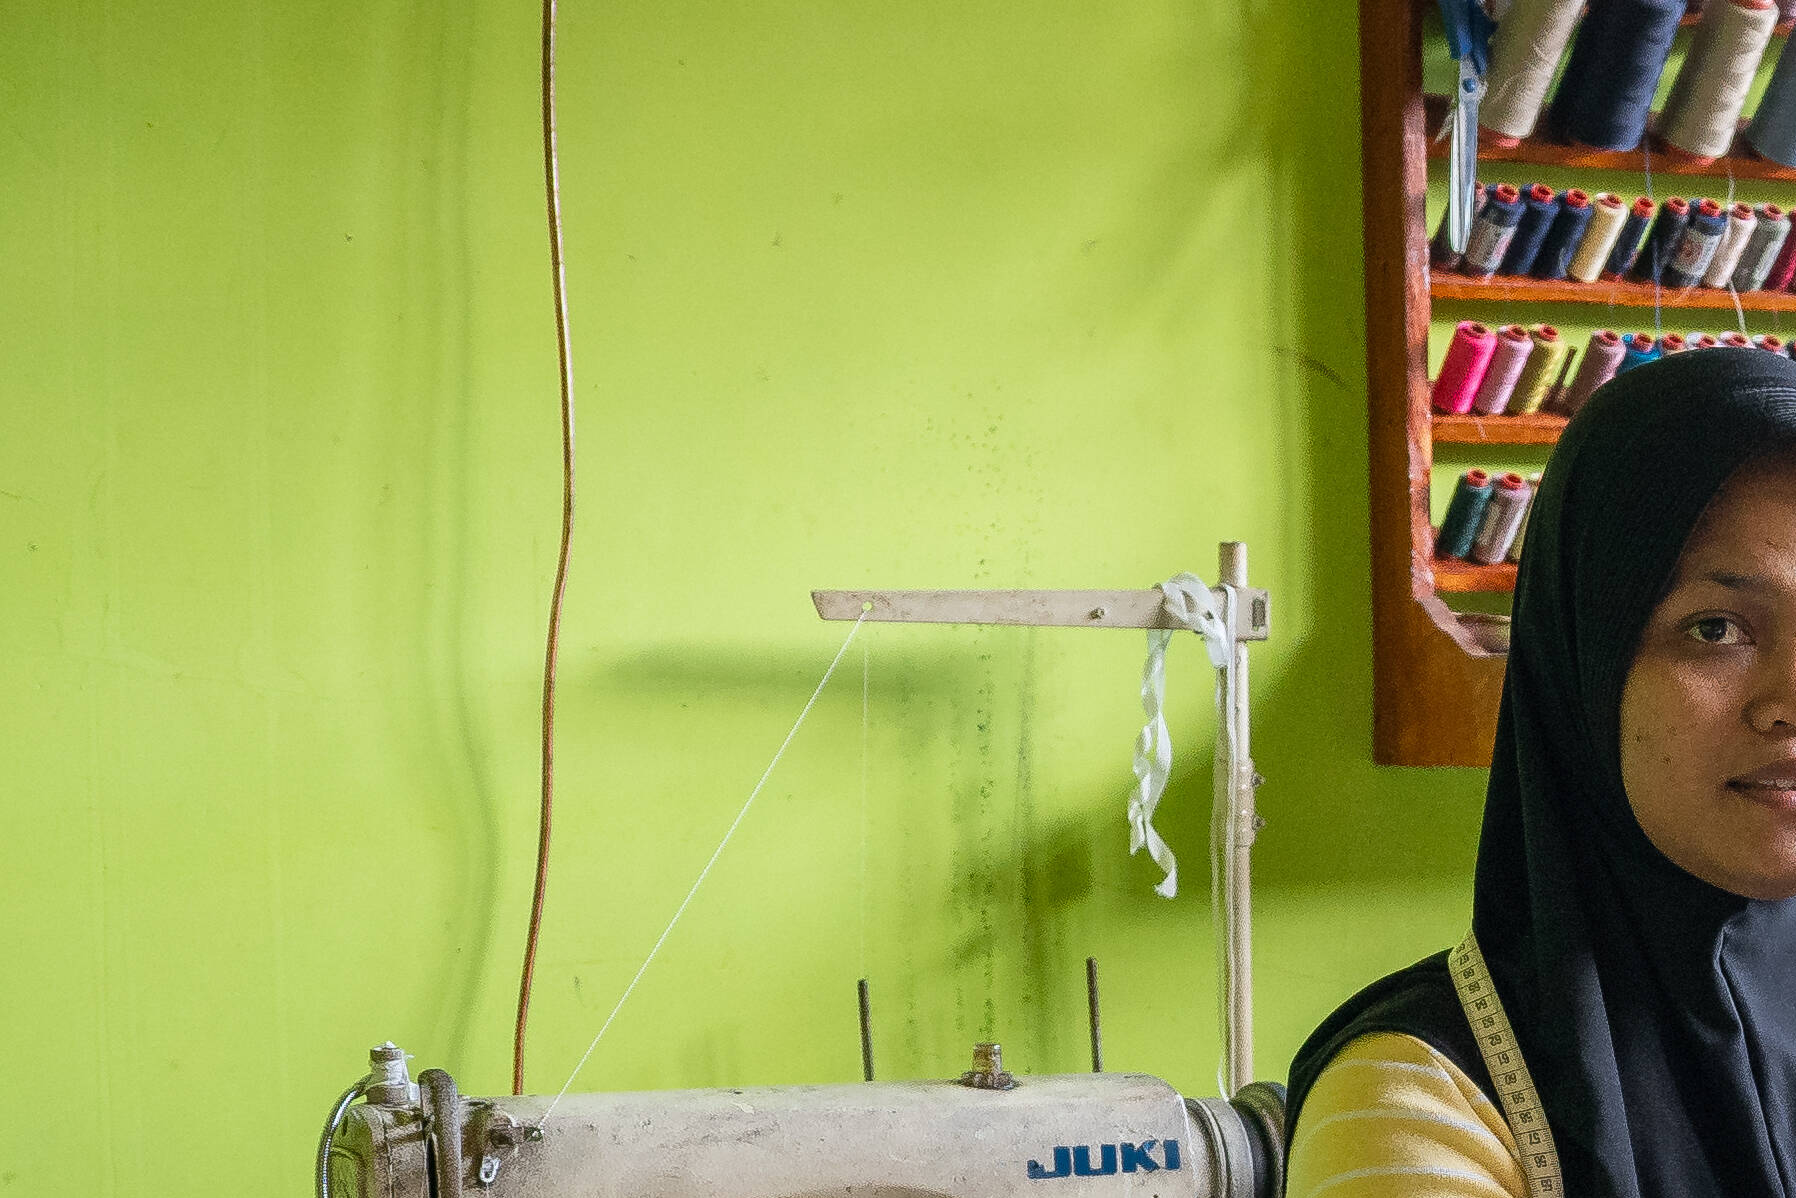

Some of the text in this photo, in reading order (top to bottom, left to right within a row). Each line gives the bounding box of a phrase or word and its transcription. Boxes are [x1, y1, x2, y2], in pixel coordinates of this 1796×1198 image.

[1475, 998, 1488, 1011] 64
[1482, 1017, 1494, 1028] 63
[1488, 1034, 1502, 1046] 62
[1497, 1053, 1510, 1065] 61
[1505, 1073, 1517, 1085] 60
[1511, 1092, 1525, 1104] 59
[1519, 1111, 1533, 1123] 58
[1529, 1132, 1540, 1145] 57
[1027, 1139, 1181, 1180] JUKI
[1541, 1179, 1553, 1192] 55
